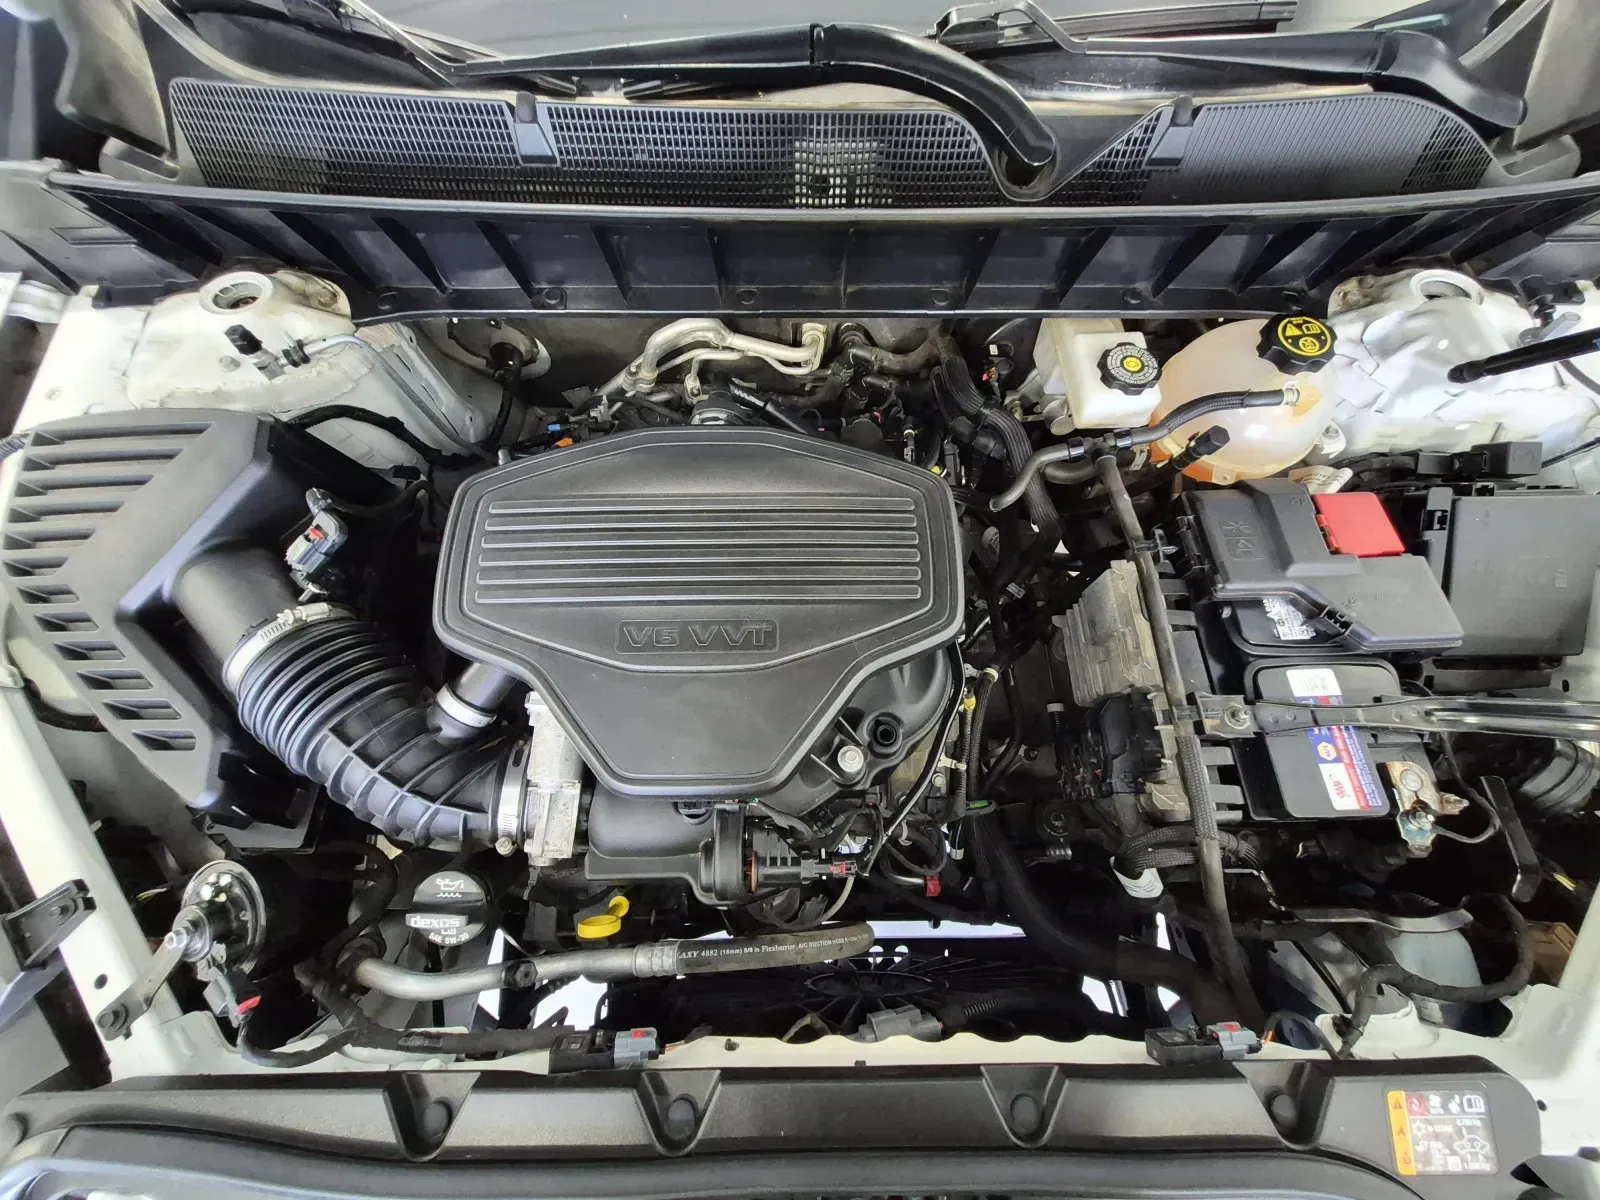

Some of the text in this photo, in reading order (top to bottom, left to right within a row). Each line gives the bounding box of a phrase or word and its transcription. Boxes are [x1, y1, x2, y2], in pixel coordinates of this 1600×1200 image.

[623, 624, 773, 647] V6 VVT
[410, 915, 461, 929] dexos
[428, 932, 469, 945] SAE 5W-30
[701, 949, 718, 957] 4882
[720, 948, 743, 956] (16mm)
[743, 946, 753, 954] 5/8
[761, 944, 795, 953] Flexbarrier
[809, 939, 832, 948] SUCTION
